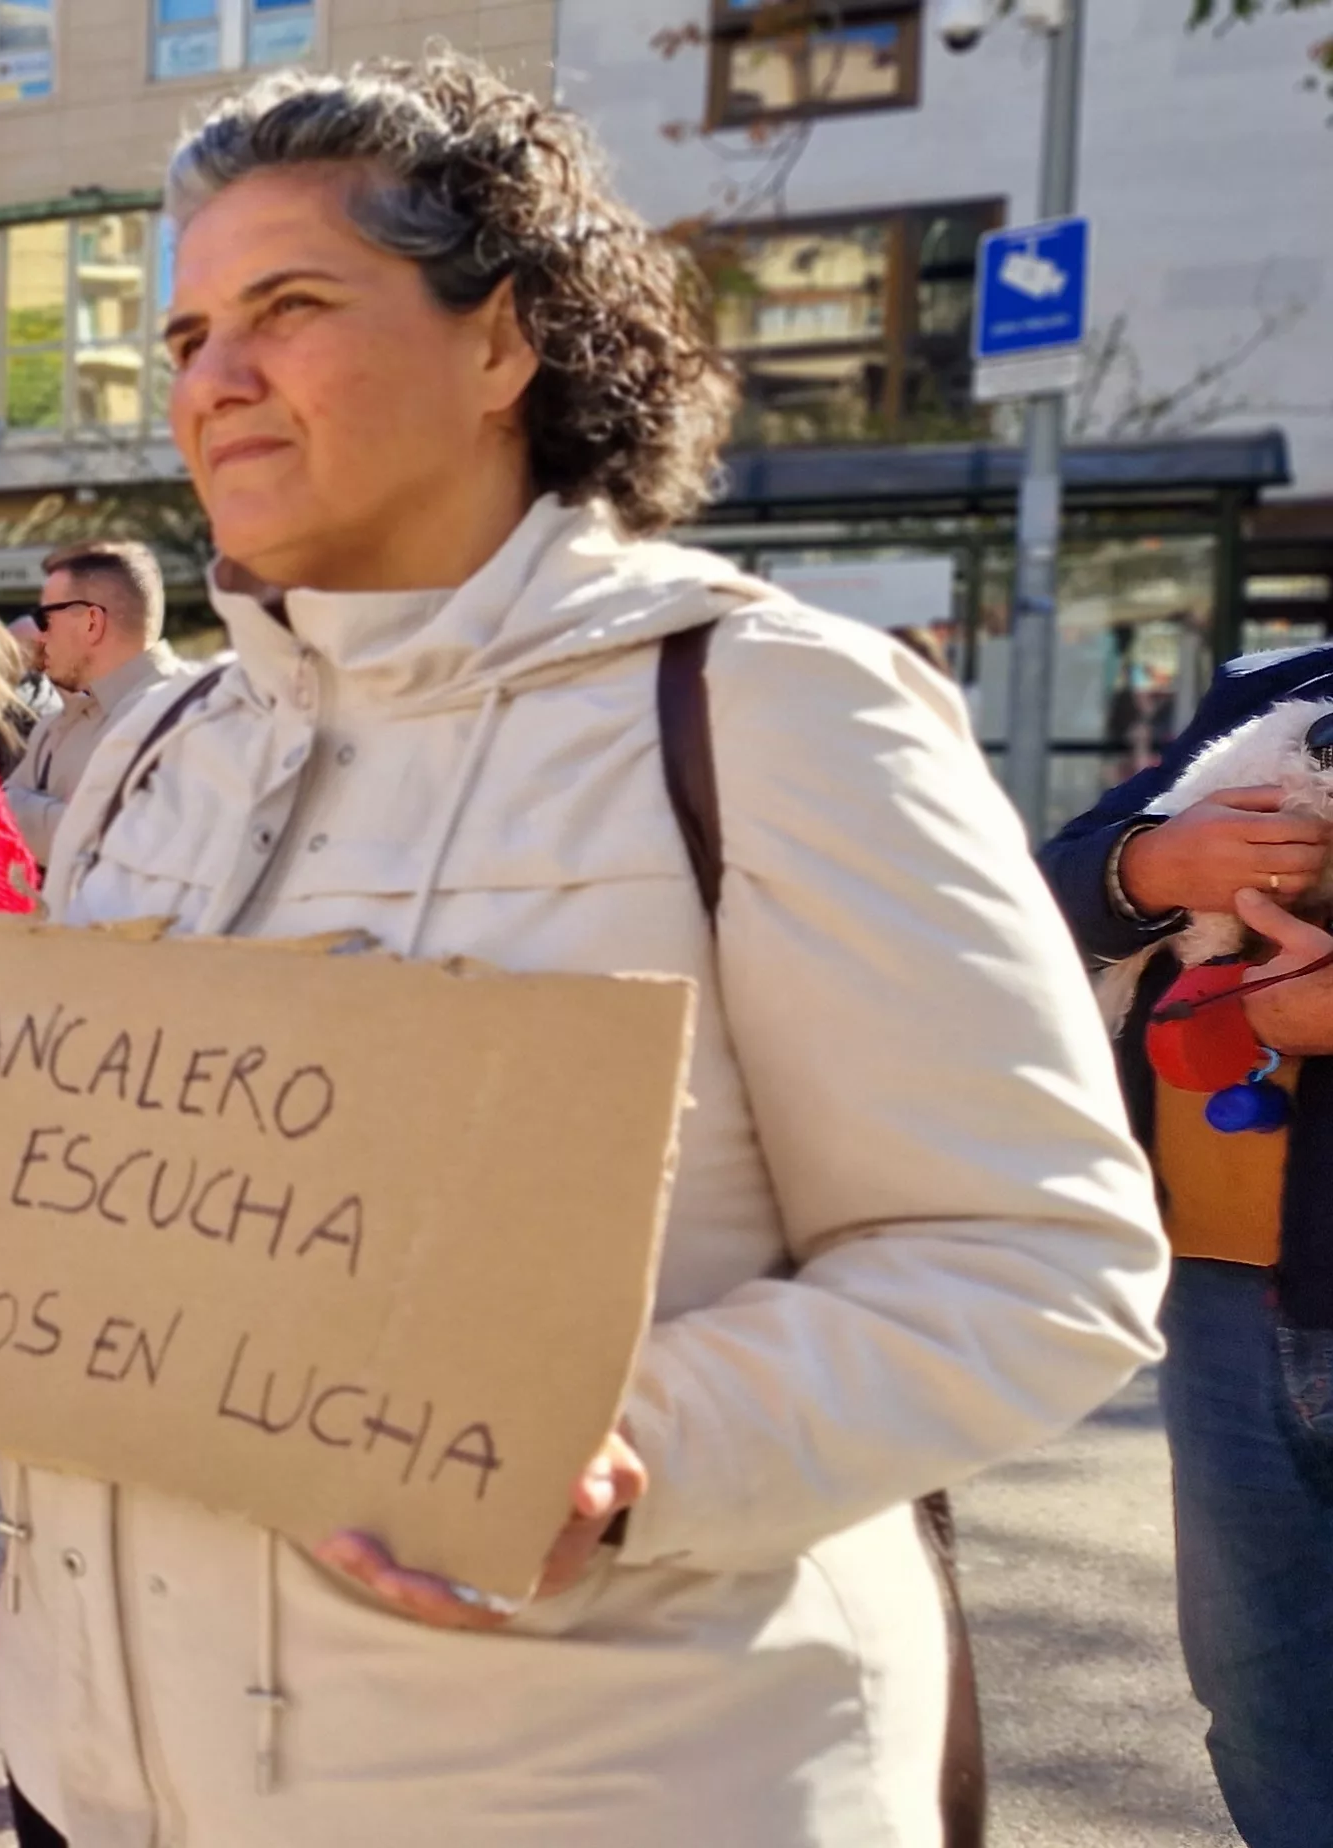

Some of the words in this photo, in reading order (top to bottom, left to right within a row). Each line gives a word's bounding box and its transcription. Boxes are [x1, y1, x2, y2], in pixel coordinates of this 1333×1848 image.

[10, 1125, 365, 1278] ESCUCHA
[85, 1308, 184, 1387] EN
[217, 1332, 503, 1499] LUCHA
